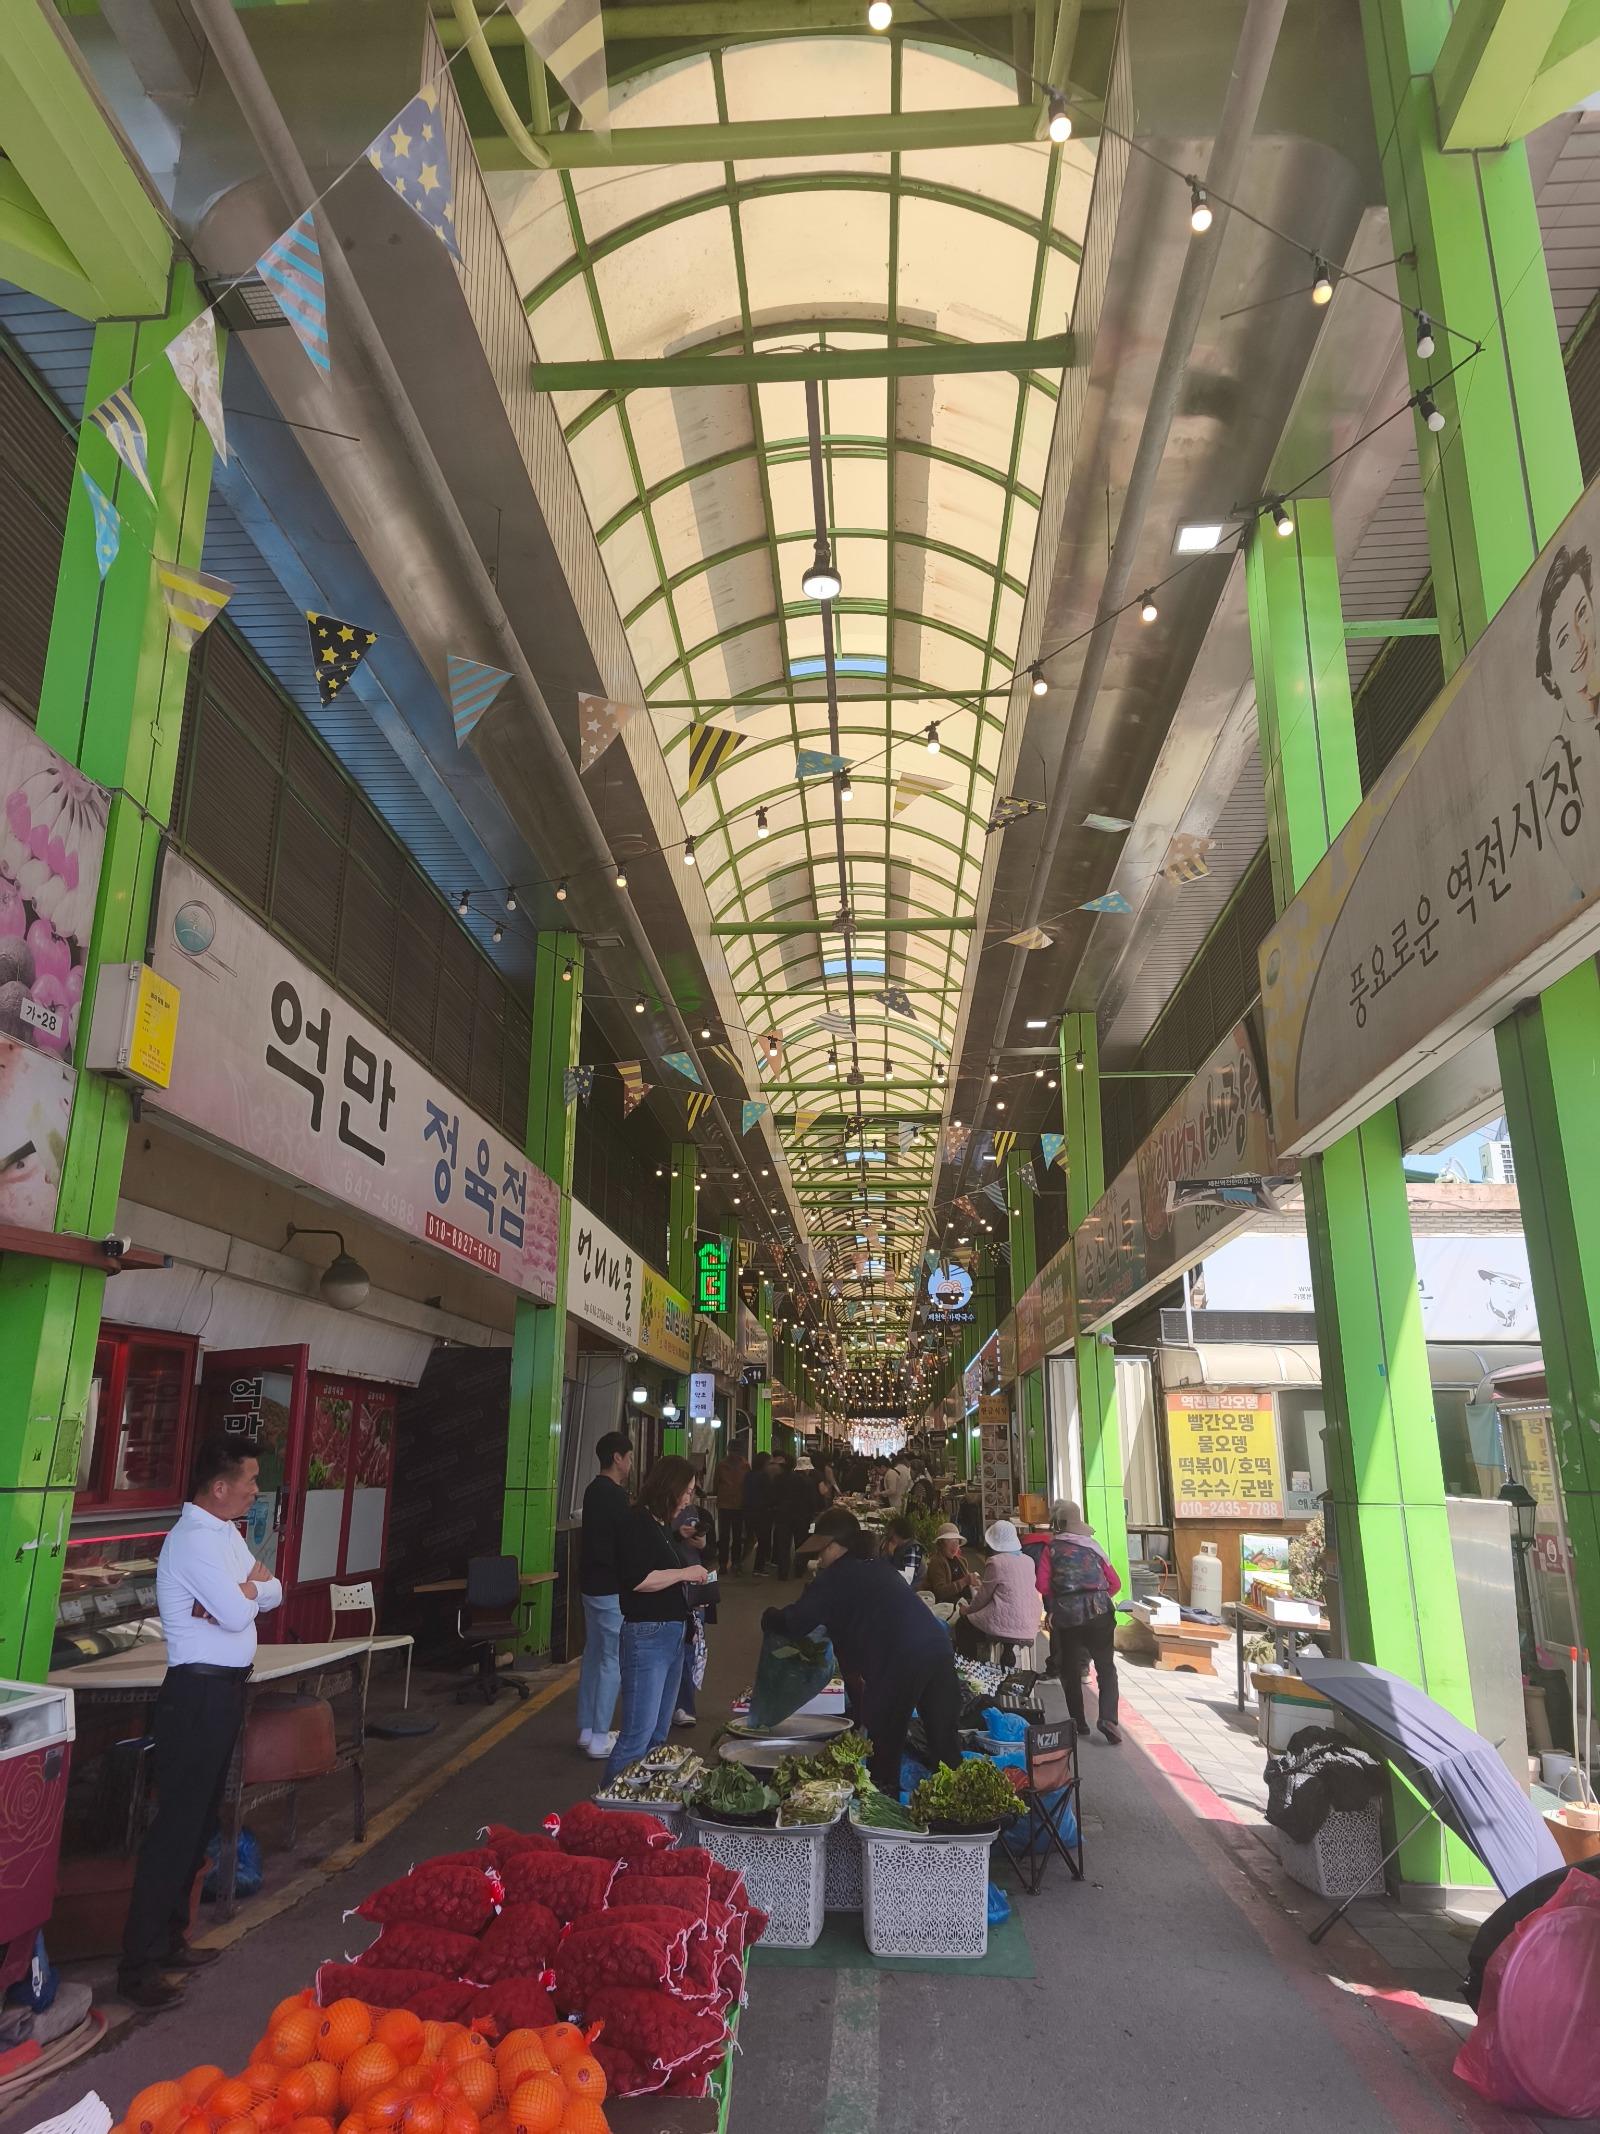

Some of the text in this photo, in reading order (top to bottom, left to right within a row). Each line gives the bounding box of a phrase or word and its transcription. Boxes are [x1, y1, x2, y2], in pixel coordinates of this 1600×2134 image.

[1350, 738, 1584, 1029] 풍요로운 역전시장
[26, 1004, 57, 1031] 가-28
[266, 980, 528, 1250] 억만 정육점
[1180, 1394, 1258, 1409] 역전빨간오뎅
[1187, 1413, 1255, 1432] 빨간오뎅
[1197, 1435, 1248, 1454] 물오뎅
[1178, 1457, 1272, 1476] 떡볶이/호떡
[1181, 1479, 1274, 1498] 옥수수/군밤
[1181, 1500, 1278, 1517] 010-2435-7788
